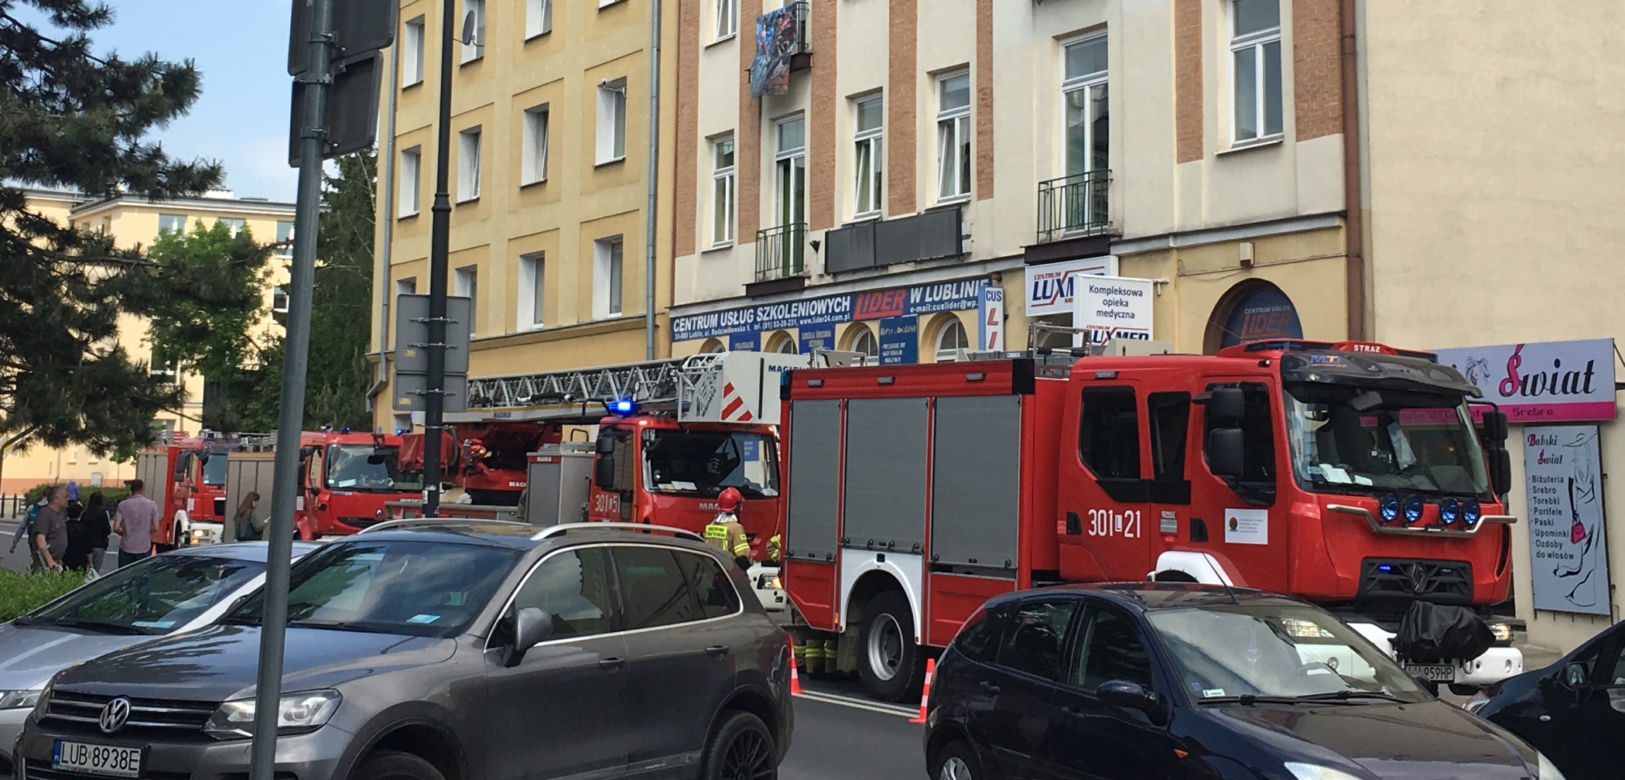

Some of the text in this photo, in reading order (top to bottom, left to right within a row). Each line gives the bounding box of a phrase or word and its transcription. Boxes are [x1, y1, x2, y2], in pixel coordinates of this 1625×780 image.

[986, 290, 1002, 301] CUS
[1089, 284, 1143, 296] Kompleksowa
[910, 300, 978, 313] e-mail:cuslider@wp.
[1103, 298, 1128, 308] opieka
[673, 313, 718, 332] CENTRUM
[720, 309, 754, 327] USŁUG
[757, 296, 850, 321] SZKOLENIOWYCH
[853, 289, 906, 320] LIDER
[910, 287, 924, 304] W
[1097, 309, 1135, 320] medyczna
[1499, 344, 1596, 397] Świat
[1528, 434, 1557, 446] Babski
[1532, 486, 1557, 494] Srebro
[1533, 497, 1560, 505] Torebki
[1534, 507, 1562, 516] Portfele
[1534, 518, 1554, 526] Paski
[1535, 529, 1569, 538] Upominki
[1536, 540, 1562, 550] Ozdoby
[61, 743, 88, 766] LUB
[92, 747, 140, 771] 8938E
